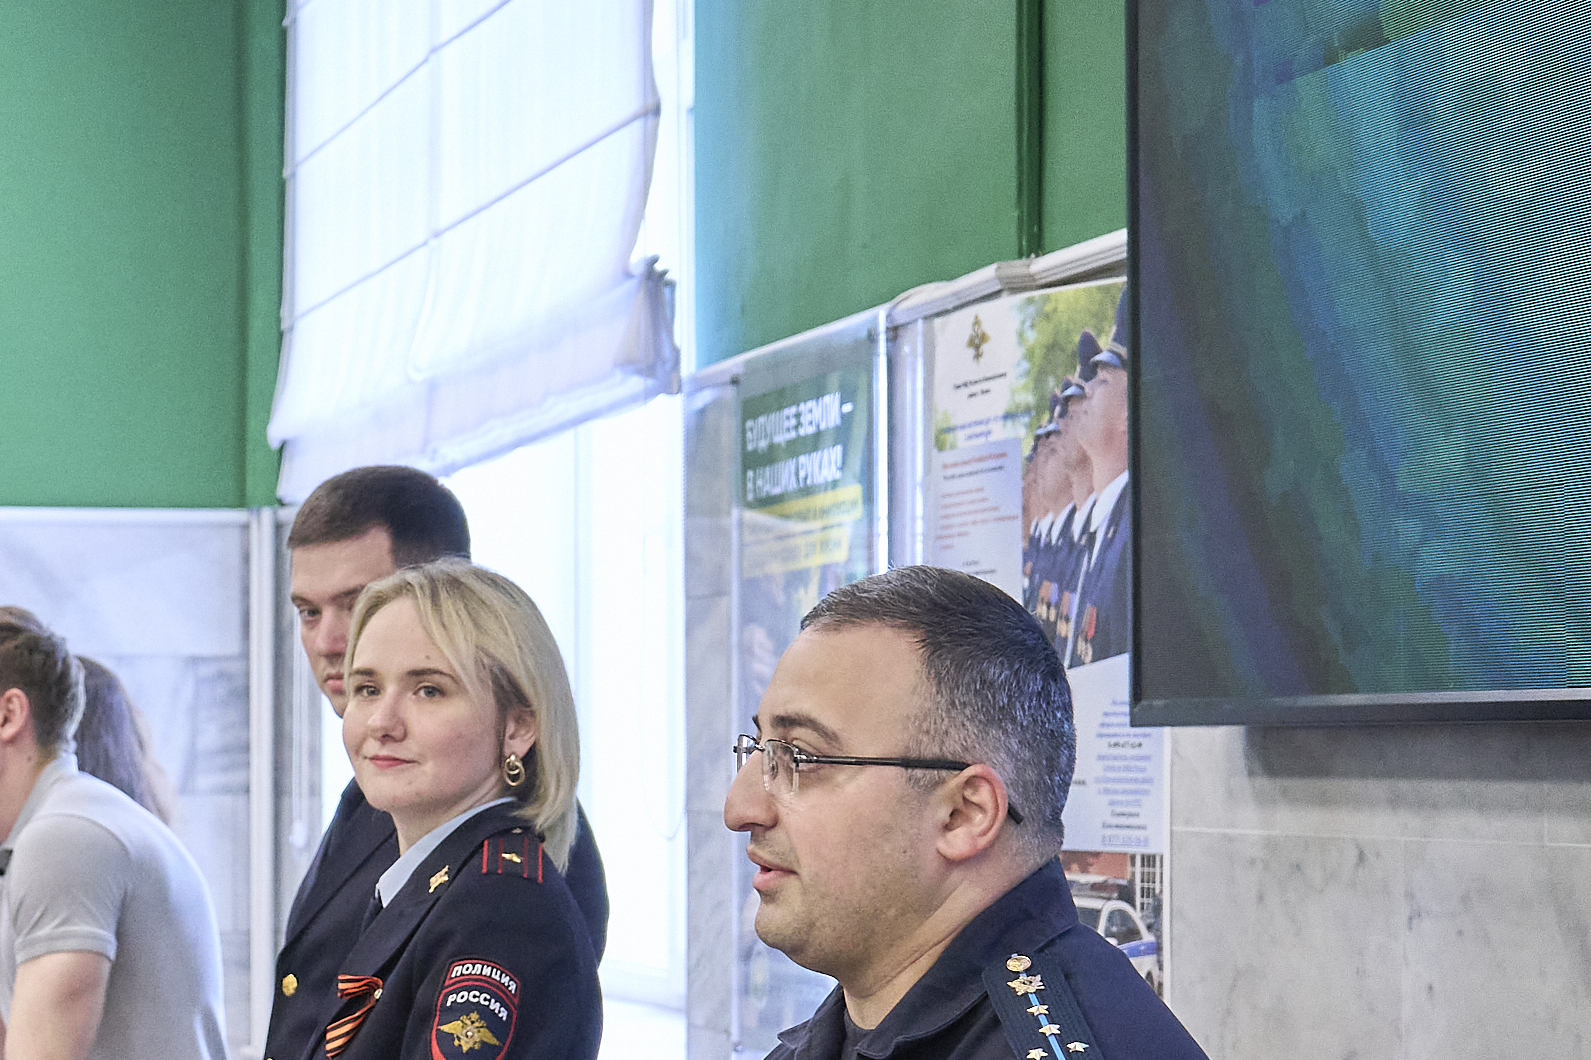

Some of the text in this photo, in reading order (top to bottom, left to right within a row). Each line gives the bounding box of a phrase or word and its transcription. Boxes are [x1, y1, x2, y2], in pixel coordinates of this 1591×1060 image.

[798, 391, 841, 437] ЗЕМЛИ
[451, 963, 517, 994] ПОЛИЦИЯ
[446, 990, 508, 1021] РОССИЯ
